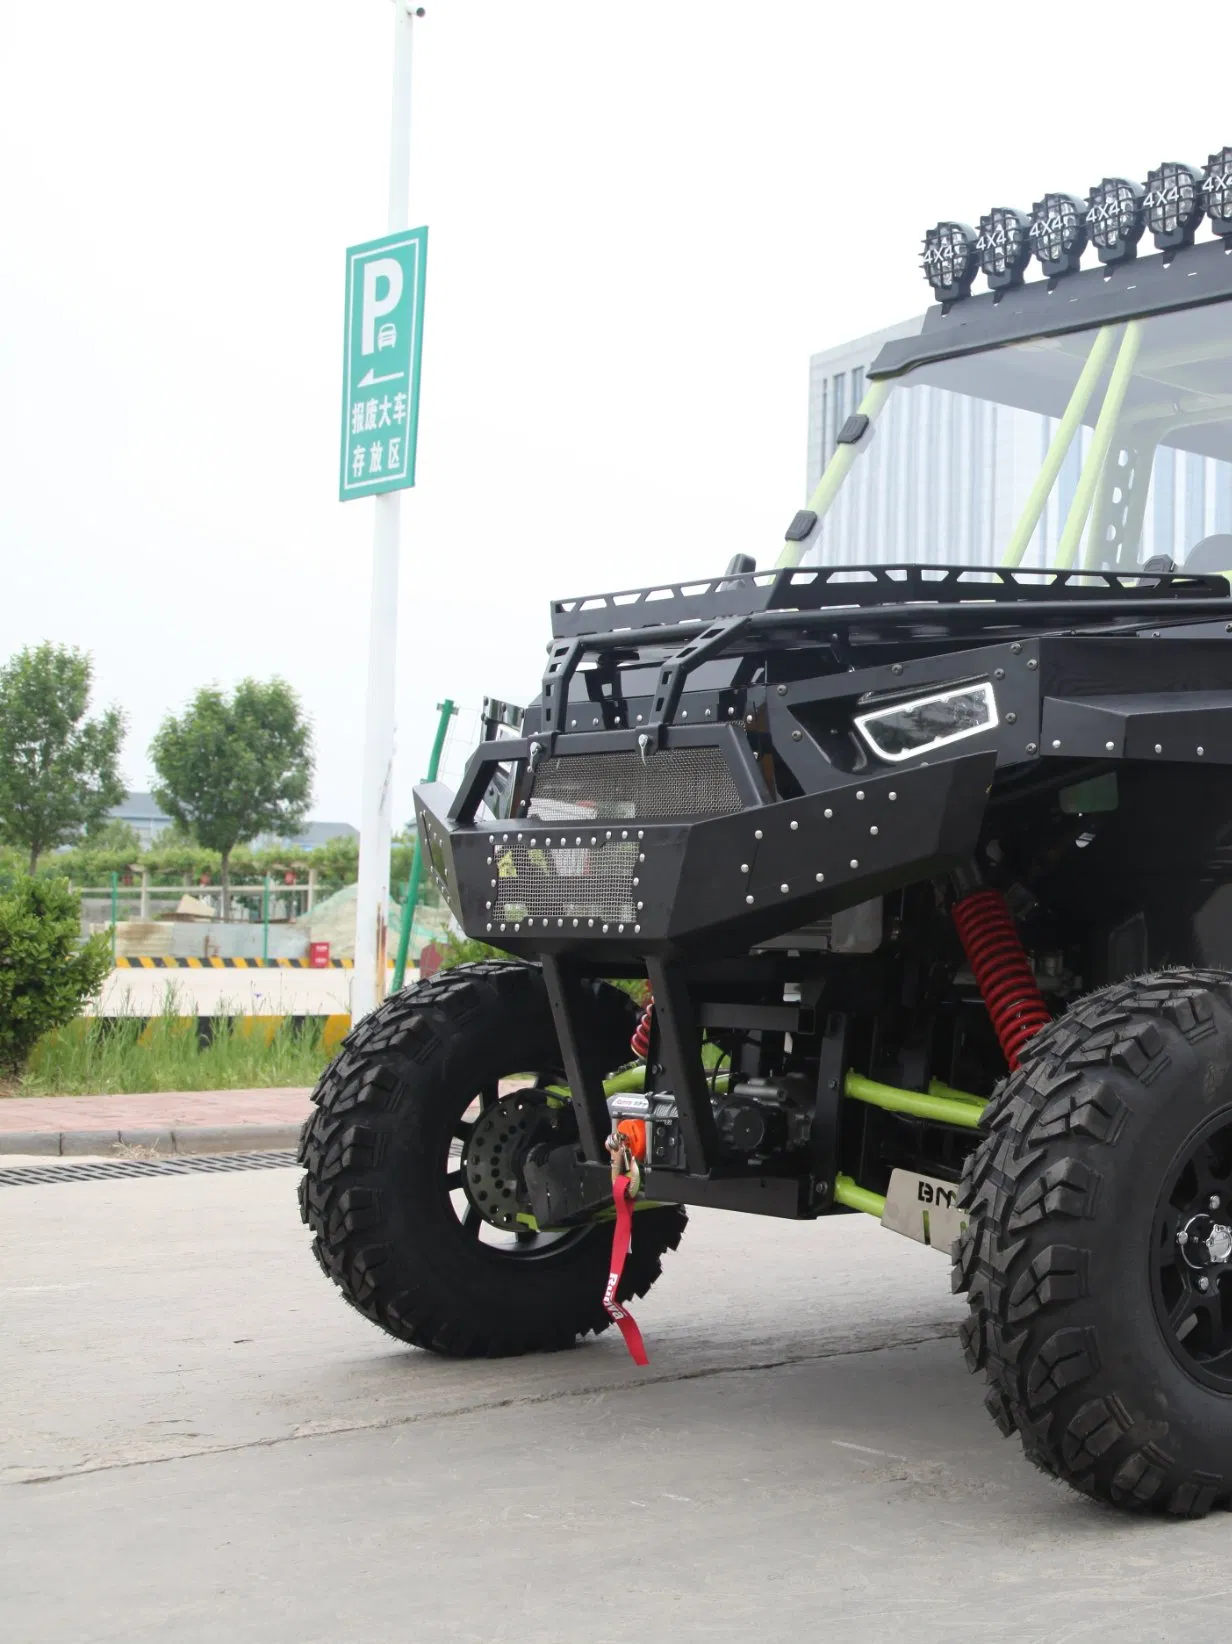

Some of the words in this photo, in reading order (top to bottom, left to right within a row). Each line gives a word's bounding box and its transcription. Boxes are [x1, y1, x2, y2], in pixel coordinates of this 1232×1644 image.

[1143, 186, 1180, 208] 4X4
[1086, 201, 1121, 223] 4X4
[1029, 216, 1063, 238] 4X4
[976, 231, 1007, 251] 4X4
[923, 244, 954, 264] 4X4
[361, 258, 404, 356] P
[351, 391, 407, 435] 报废大车
[352, 437, 401, 477] 存放区
